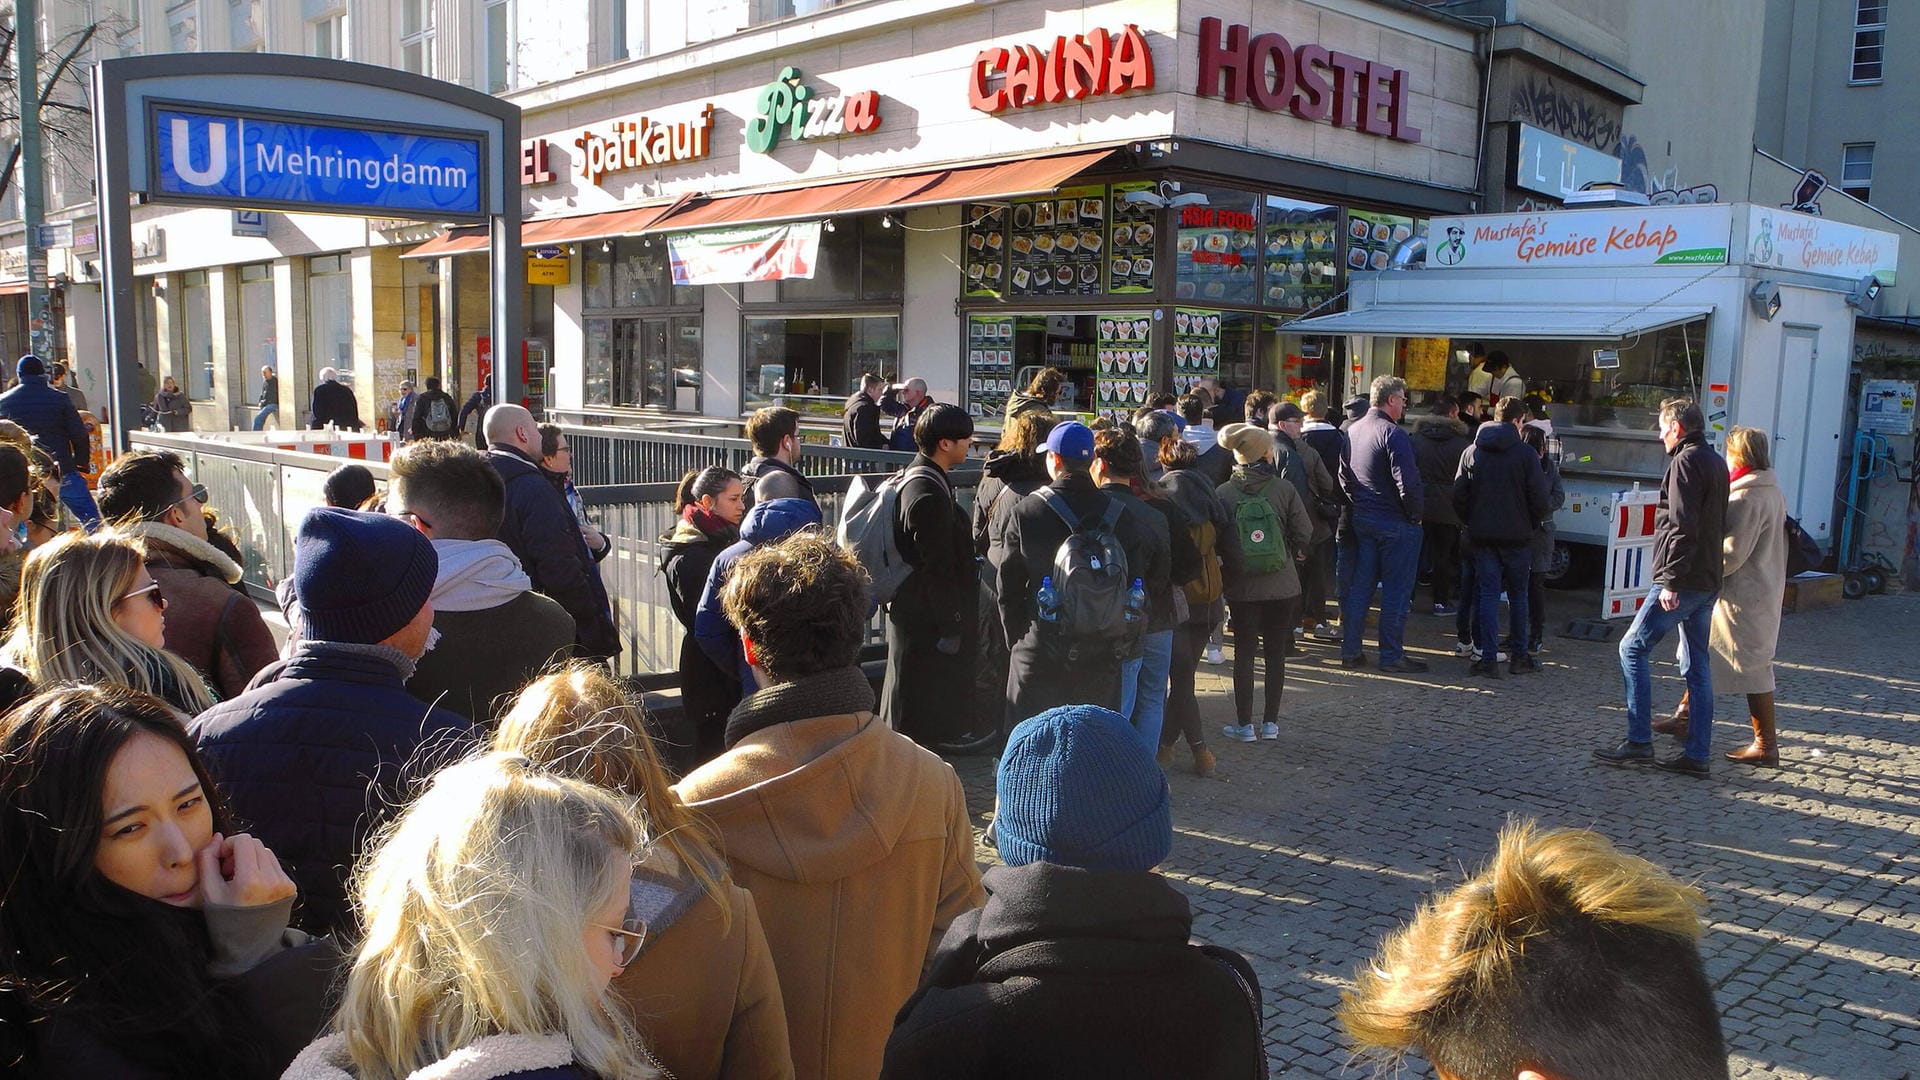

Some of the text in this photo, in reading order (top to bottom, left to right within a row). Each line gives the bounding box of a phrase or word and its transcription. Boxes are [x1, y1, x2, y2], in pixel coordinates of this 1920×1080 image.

[968, 23, 1155, 113] CHINA
[1198, 16, 1421, 143] HOSTEL
[746, 66, 881, 154] Pizza
[170, 118, 468, 189] U Mehringdamm
[520, 139, 554, 185] EL
[571, 102, 715, 184] Spätkauf
[1181, 205, 1256, 231] ASIA FOOD
[1473, 216, 1549, 245] Mustafa's
[1777, 220, 1820, 242] Mustafa's
[1516, 219, 1678, 264] Gemüse Kebap
[1801, 237, 1879, 272] Gemüse Kebap
